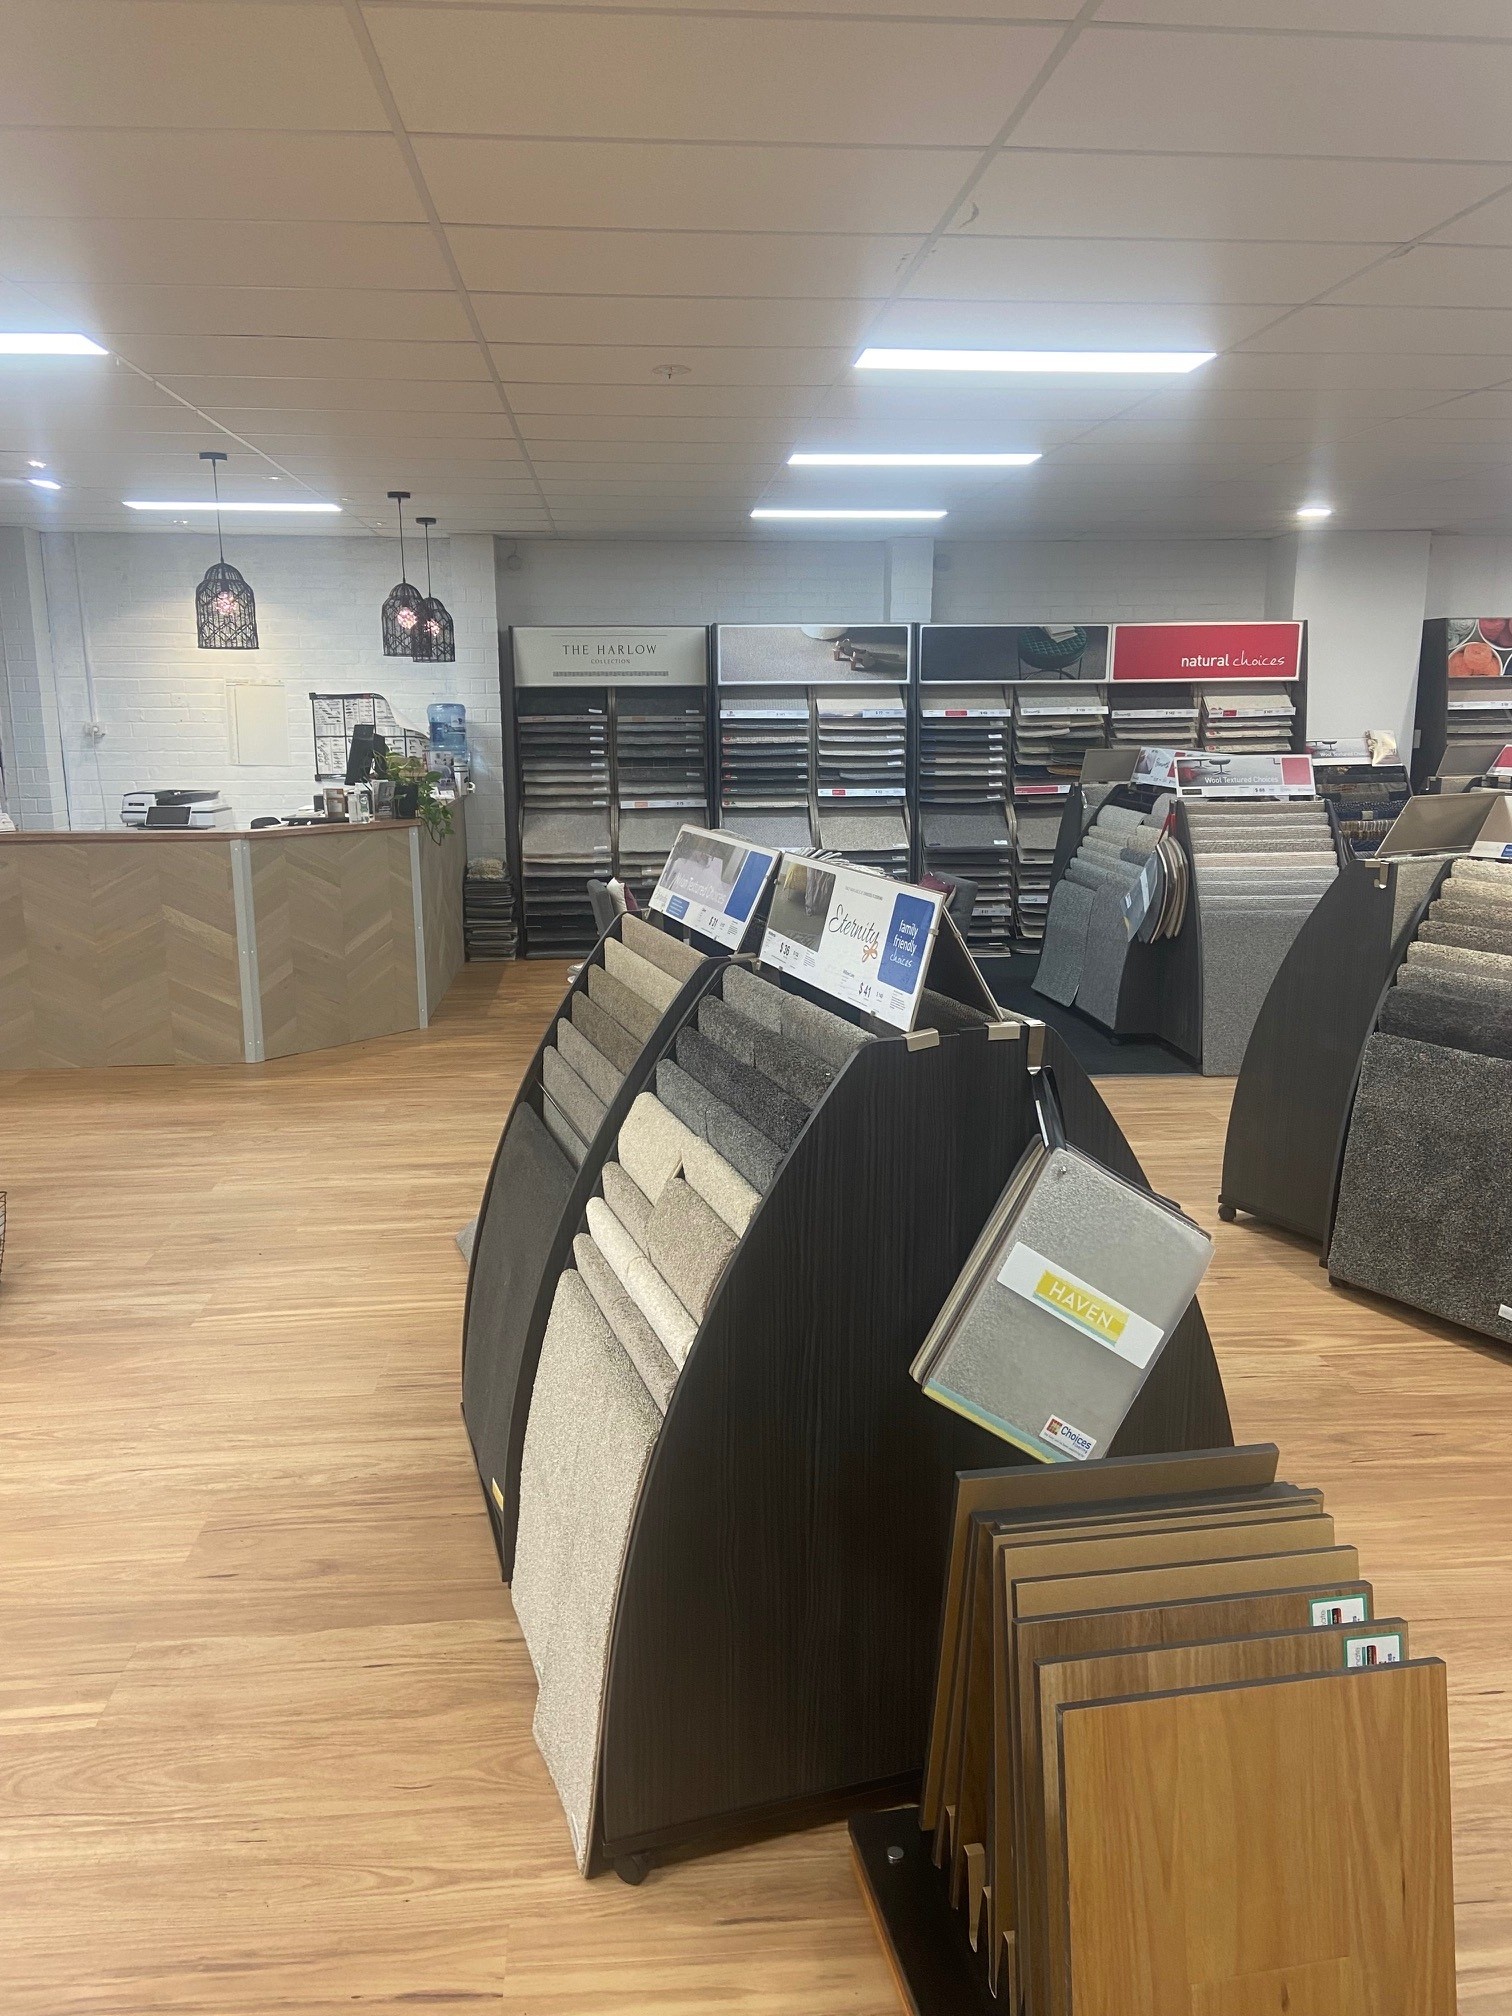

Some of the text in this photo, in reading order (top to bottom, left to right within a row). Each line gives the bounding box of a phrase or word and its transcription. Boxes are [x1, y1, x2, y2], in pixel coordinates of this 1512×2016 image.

[562, 644, 658, 655] THE HARLOW
[1181, 650, 1285, 667] natural choices
[1204, 776, 1222, 784] Wool
[1253, 775, 1279, 783] Choices
[828, 904, 880, 945] Eternity
[899, 919, 919, 940] family
[893, 933, 918, 956] friendly
[889, 948, 913, 967] choices
[1049, 1281, 1114, 1329] HAVEN
[1060, 1425, 1092, 1449] Choices
